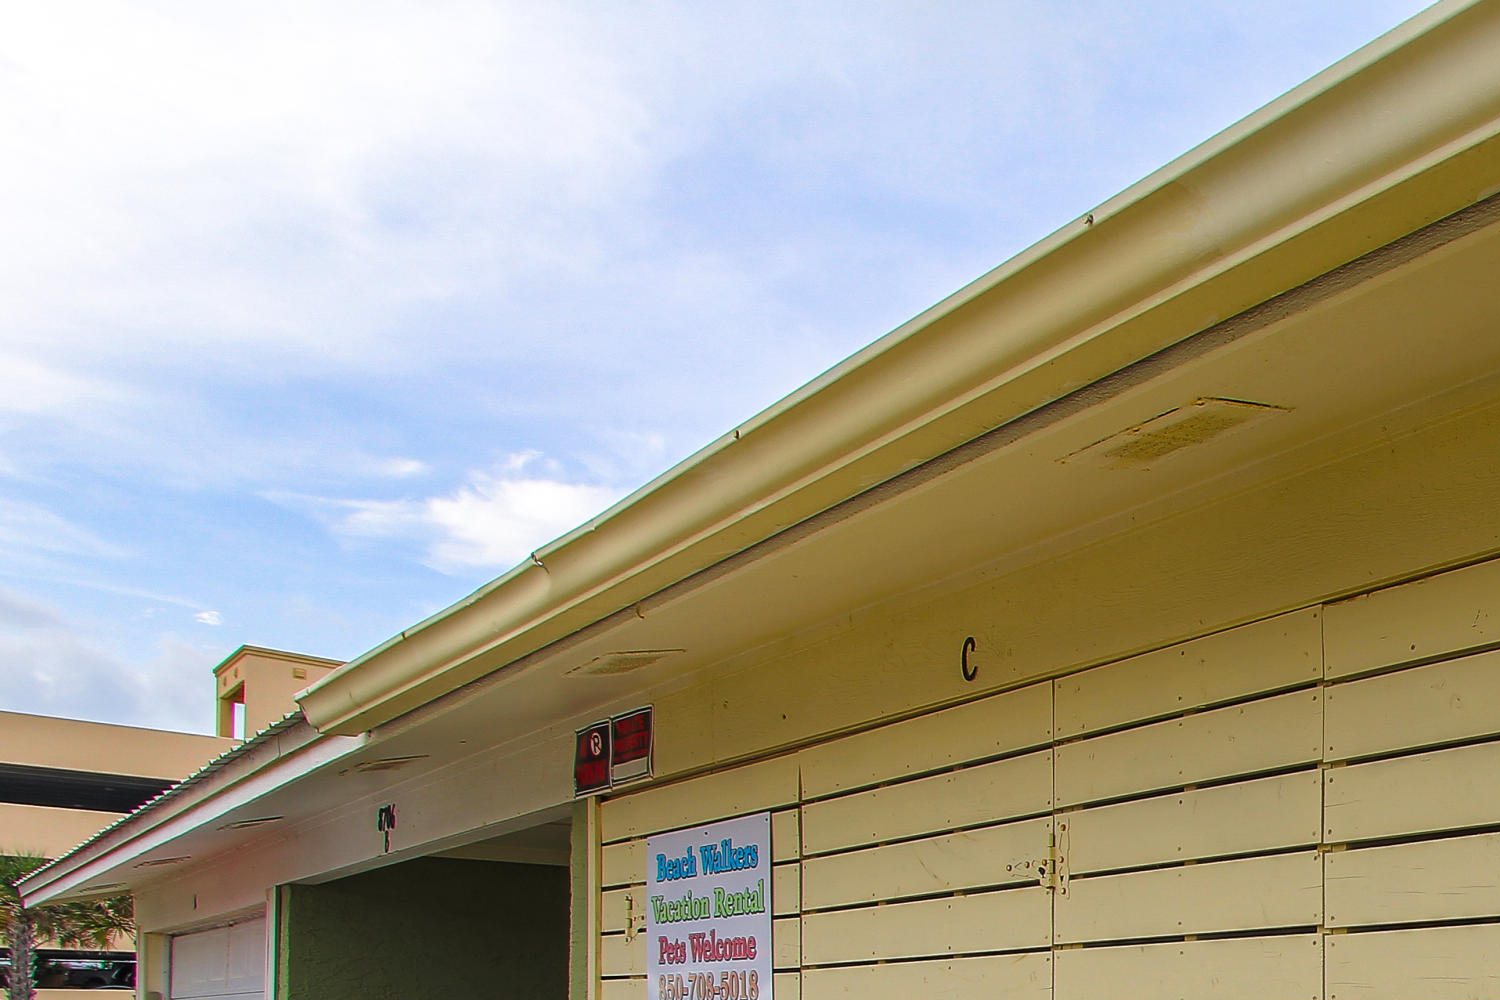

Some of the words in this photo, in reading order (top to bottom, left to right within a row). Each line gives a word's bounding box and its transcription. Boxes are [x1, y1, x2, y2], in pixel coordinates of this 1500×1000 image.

[962, 636, 978, 682] C
[656, 846, 697, 882] Beach
[699, 838, 759, 875] Walkers
[651, 889, 711, 924] Vacation
[713, 878, 765, 918] Rental
[658, 936, 686, 965] Pets
[689, 929, 757, 963] Welcome
